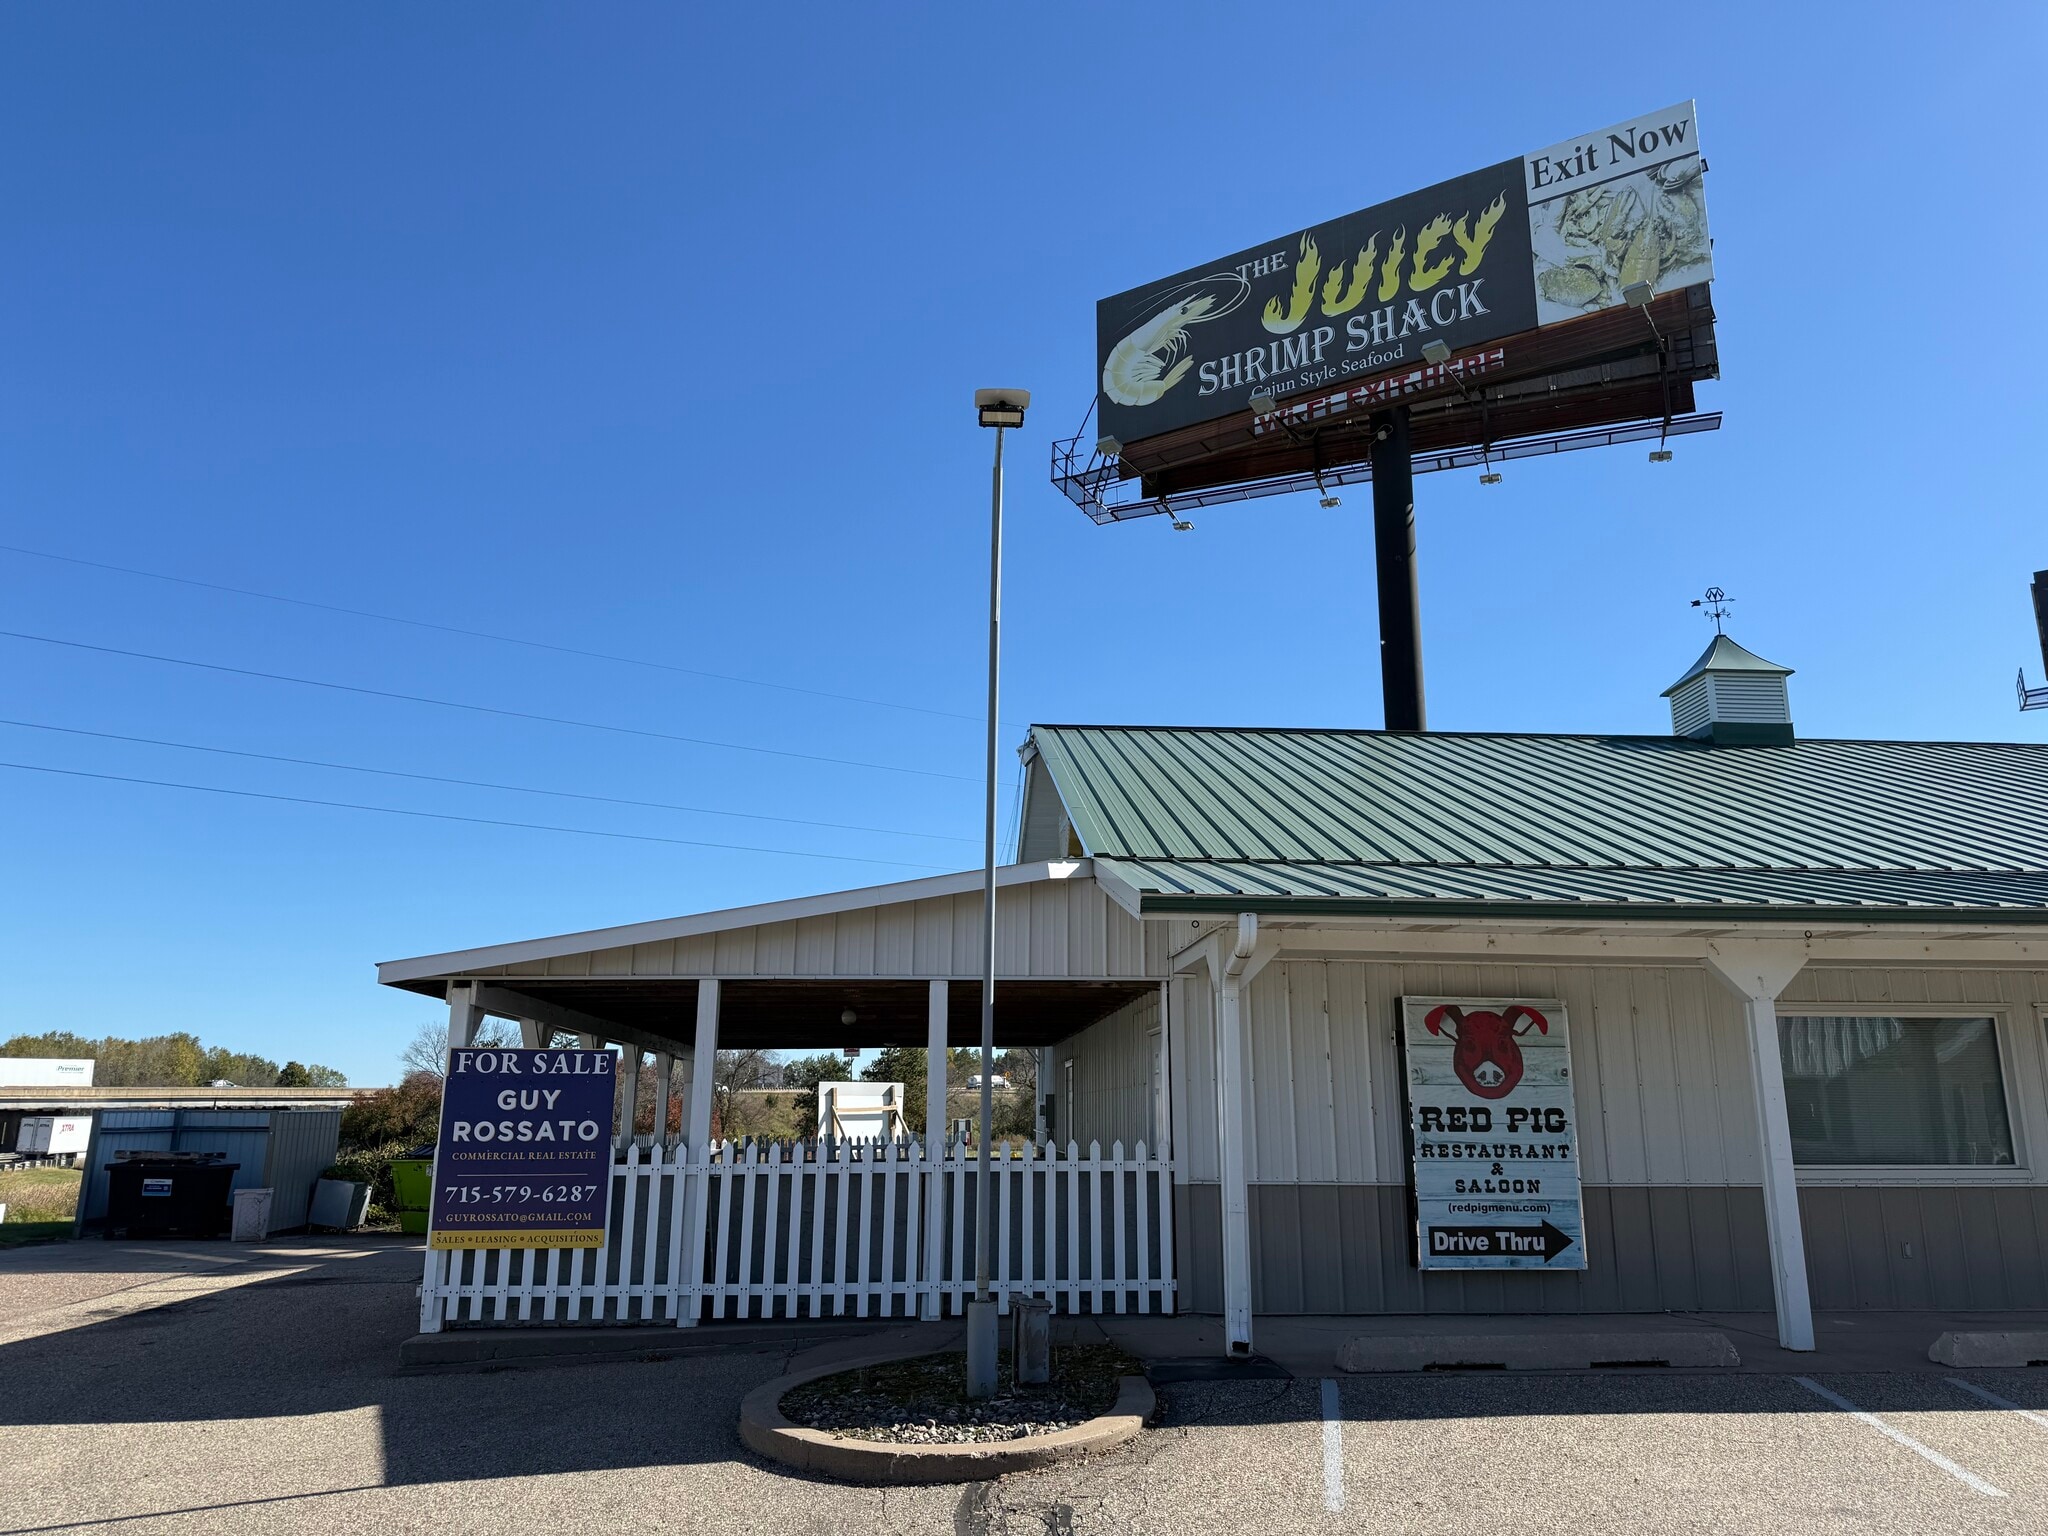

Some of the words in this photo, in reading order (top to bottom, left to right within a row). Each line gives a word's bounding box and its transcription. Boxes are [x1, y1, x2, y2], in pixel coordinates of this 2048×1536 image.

[1530, 144, 1599, 190] Exit
[1606, 120, 1689, 165] Now
[1235, 251, 1288, 280] THE
[1261, 188, 1507, 335] JUICY
[1198, 325, 1336, 396] SHRIMP
[1345, 278, 1491, 352] SHACK
[1252, 378, 1296, 399] Cajun
[1300, 363, 1337, 387] Style
[1341, 345, 1405, 373] Seafood
[1347, 374, 1410, 407] EXIT
[1421, 350, 1503, 388] HERE
[456, 1052, 522, 1075] FOR
[532, 1053, 610, 1075] SALE
[497, 1089, 561, 1111] GUY
[1418, 1106, 1492, 1133] RED
[1506, 1107, 1567, 1133] PIG
[452, 1120, 599, 1142] ROSSATO
[452, 1152, 525, 1161] COMMERCIAL
[529, 1152, 556, 1160] REAL
[558, 1151, 597, 1160] ESTATE
[1421, 1144, 1570, 1159] RESTAURANT
[1490, 1163, 1504, 1176] &
[445, 1185, 598, 1204] 715-579-6287
[1455, 1179, 1541, 1194] SALOON
[446, 1212, 592, 1222] GUYROSSATO@GMAIL.COM
[1448, 1203, 1551, 1214] (redpigmenu.com)
[436, 1236, 465, 1244] SALES
[475, 1235, 517, 1243] LEASING
[527, 1234, 599, 1243] ACQUISITIONS
[1434, 1231, 1489, 1251] Drive
[1495, 1231, 1545, 1251] Thru
